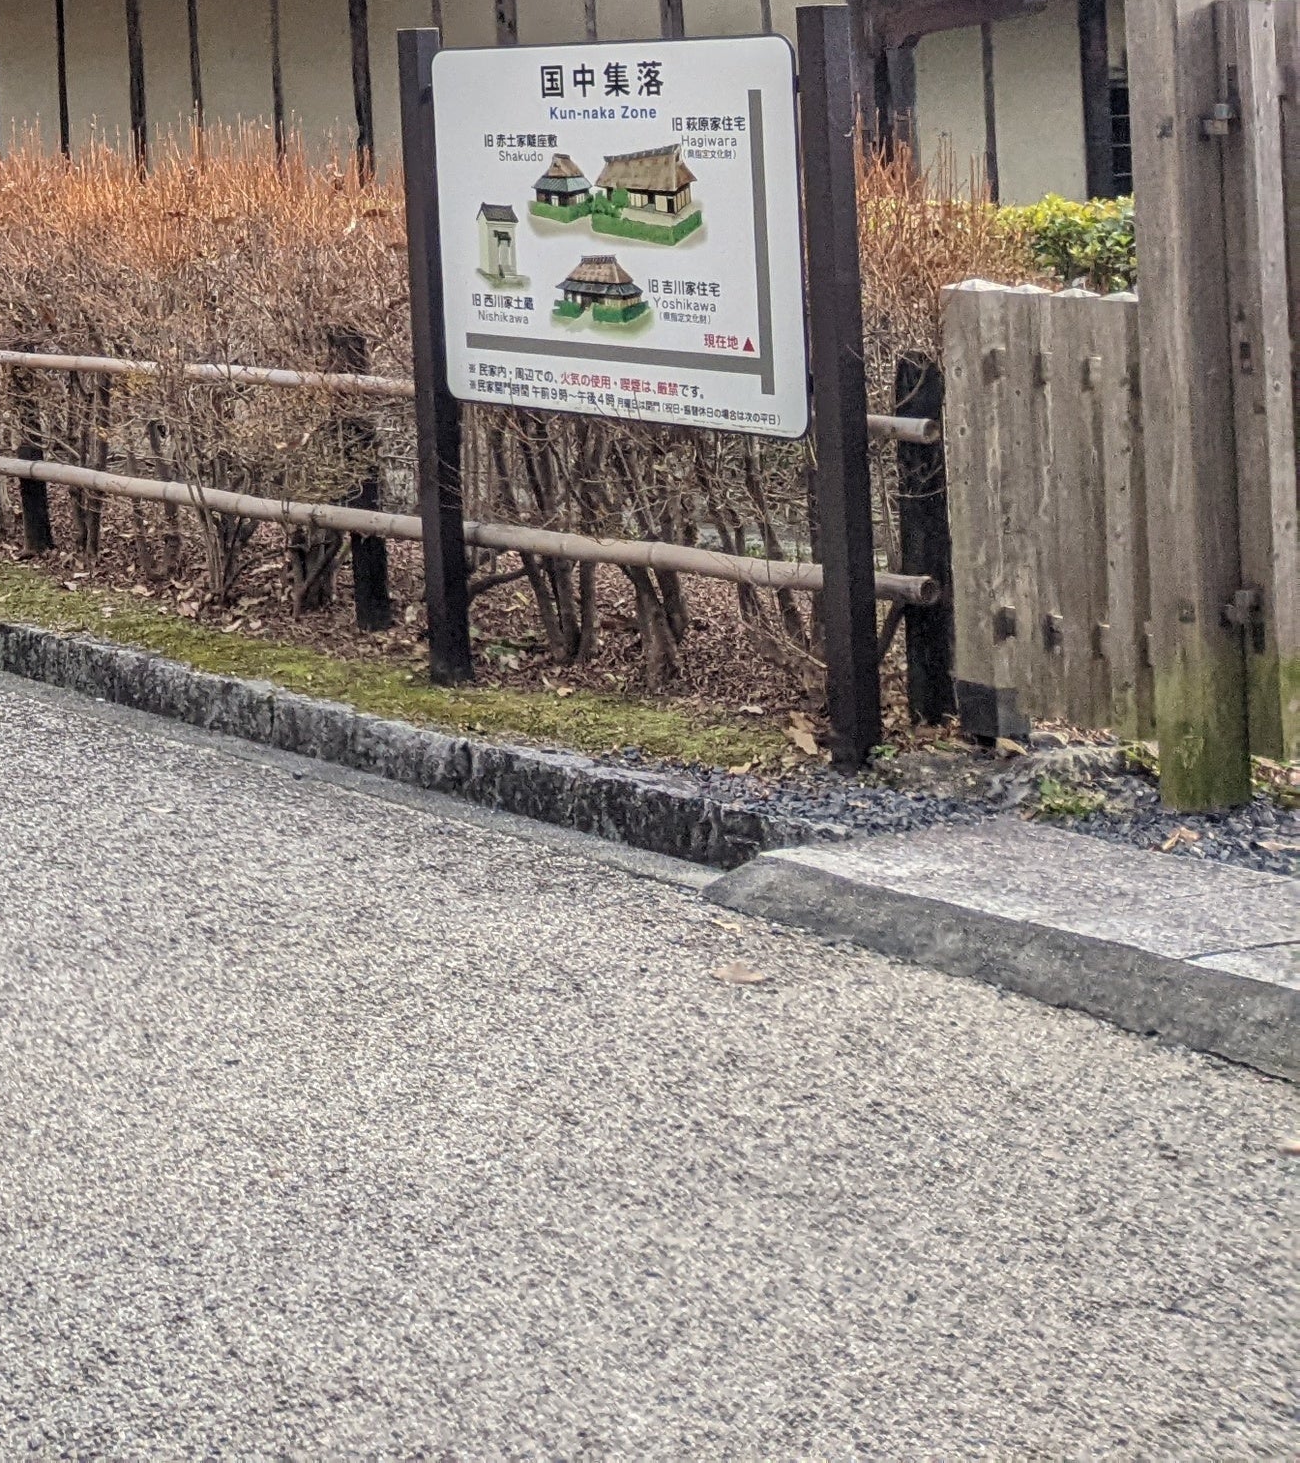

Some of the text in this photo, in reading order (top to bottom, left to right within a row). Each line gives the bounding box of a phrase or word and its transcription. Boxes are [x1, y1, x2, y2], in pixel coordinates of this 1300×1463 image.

[540, 60, 665, 99] 国中集落
[549, 105, 657, 120] Kun-naka Zone
[681, 135, 738, 148] Hagiwara
[498, 150, 544, 163] Shakudo
[653, 296, 717, 313] Yoshikawa
[478, 309, 529, 325] Nishikawa
[703, 333, 739, 350] 現在地
